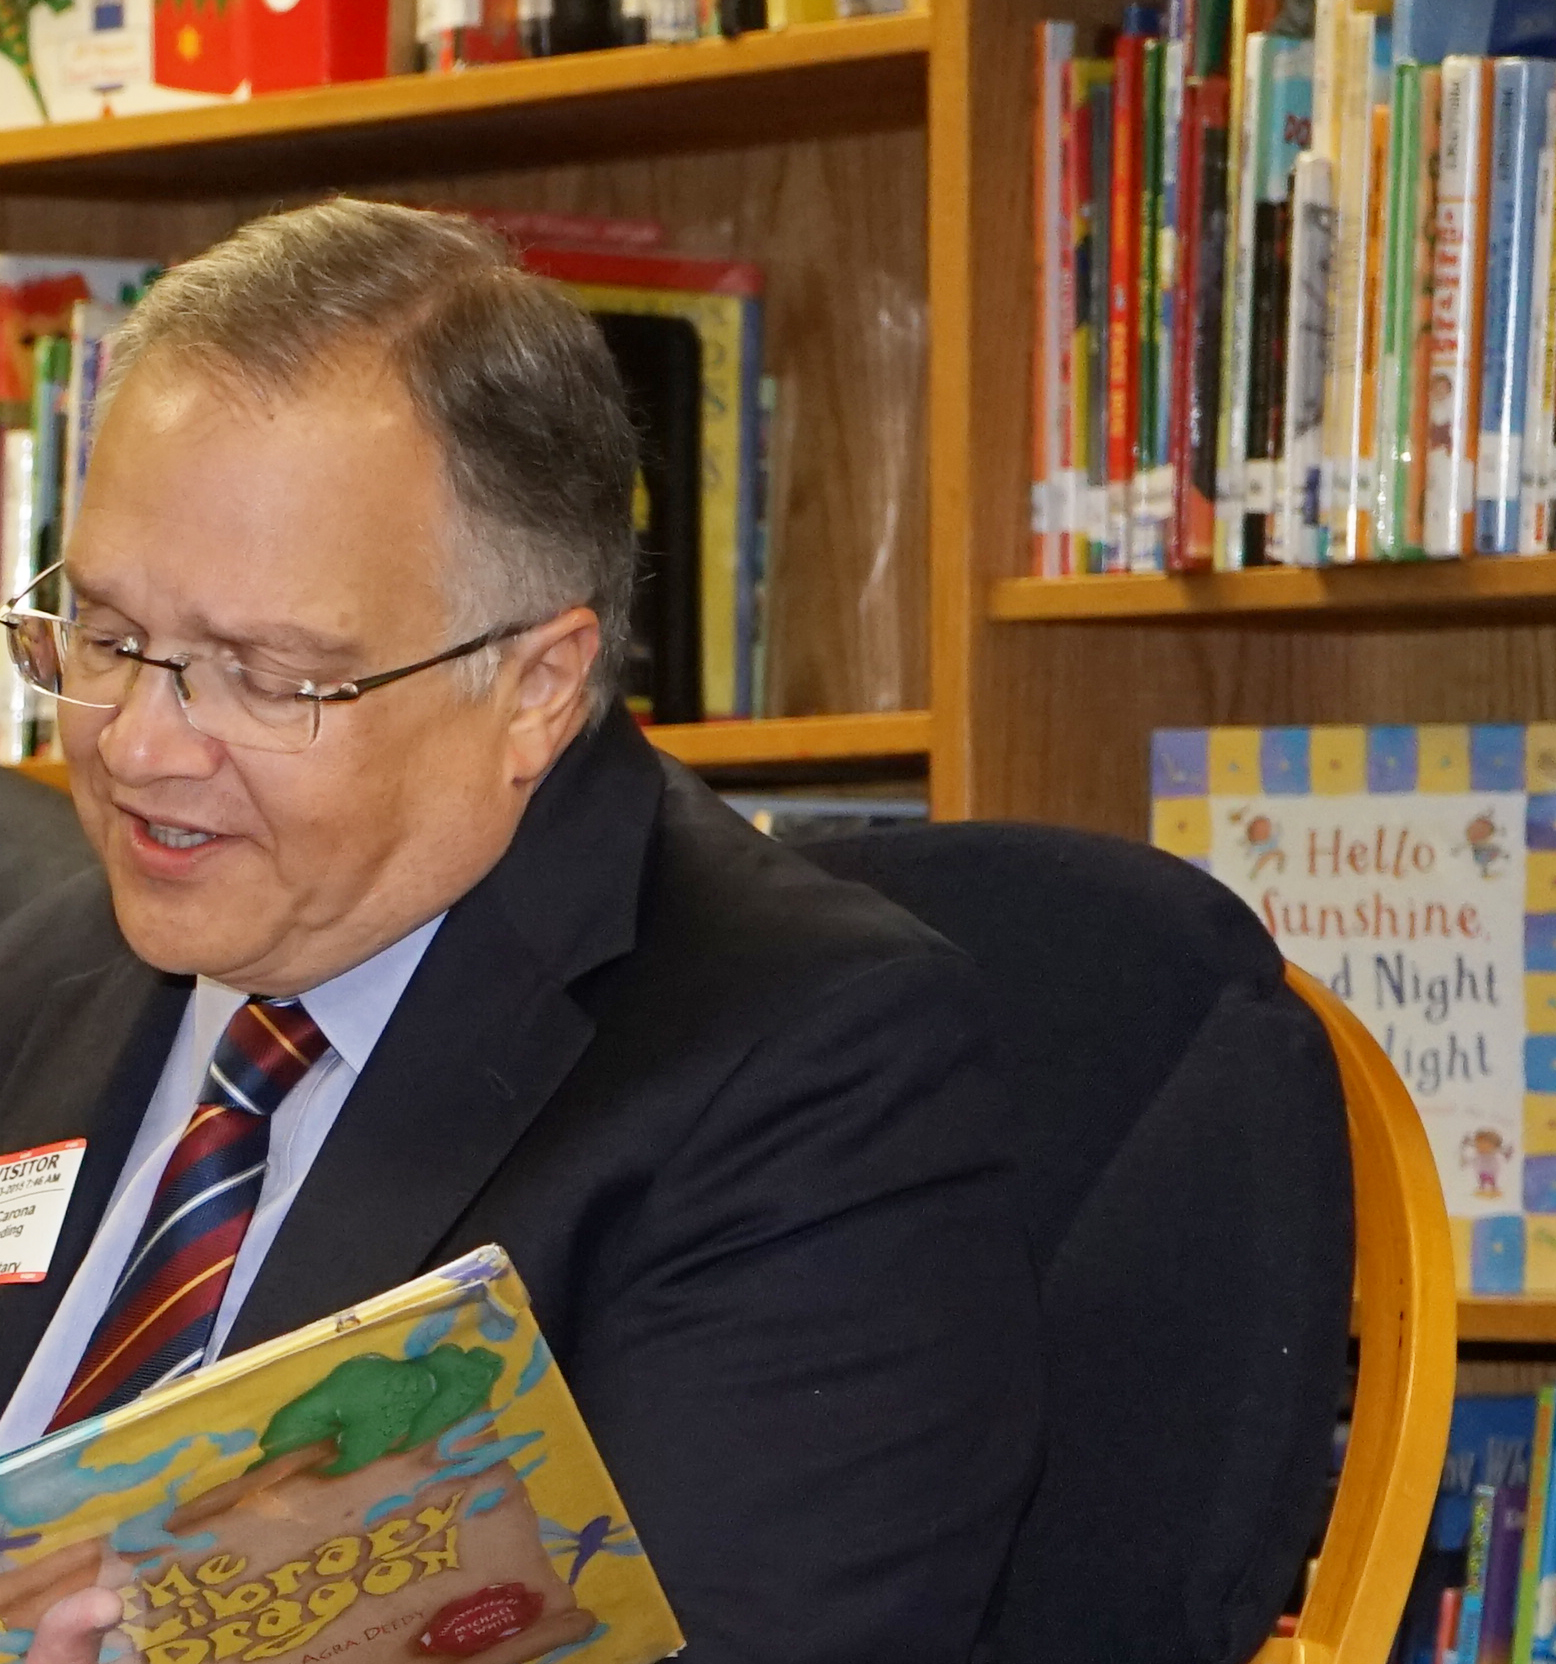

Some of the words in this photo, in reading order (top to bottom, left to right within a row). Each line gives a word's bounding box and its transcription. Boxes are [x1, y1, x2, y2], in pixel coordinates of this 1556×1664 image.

[1307, 827, 1436, 879] Hello
[1373, 952, 1499, 1026] Night
[1386, 1021, 1491, 1092] light
[45, 1173, 61, 1183] AM
[364, 1610, 425, 1642] DEEDY
